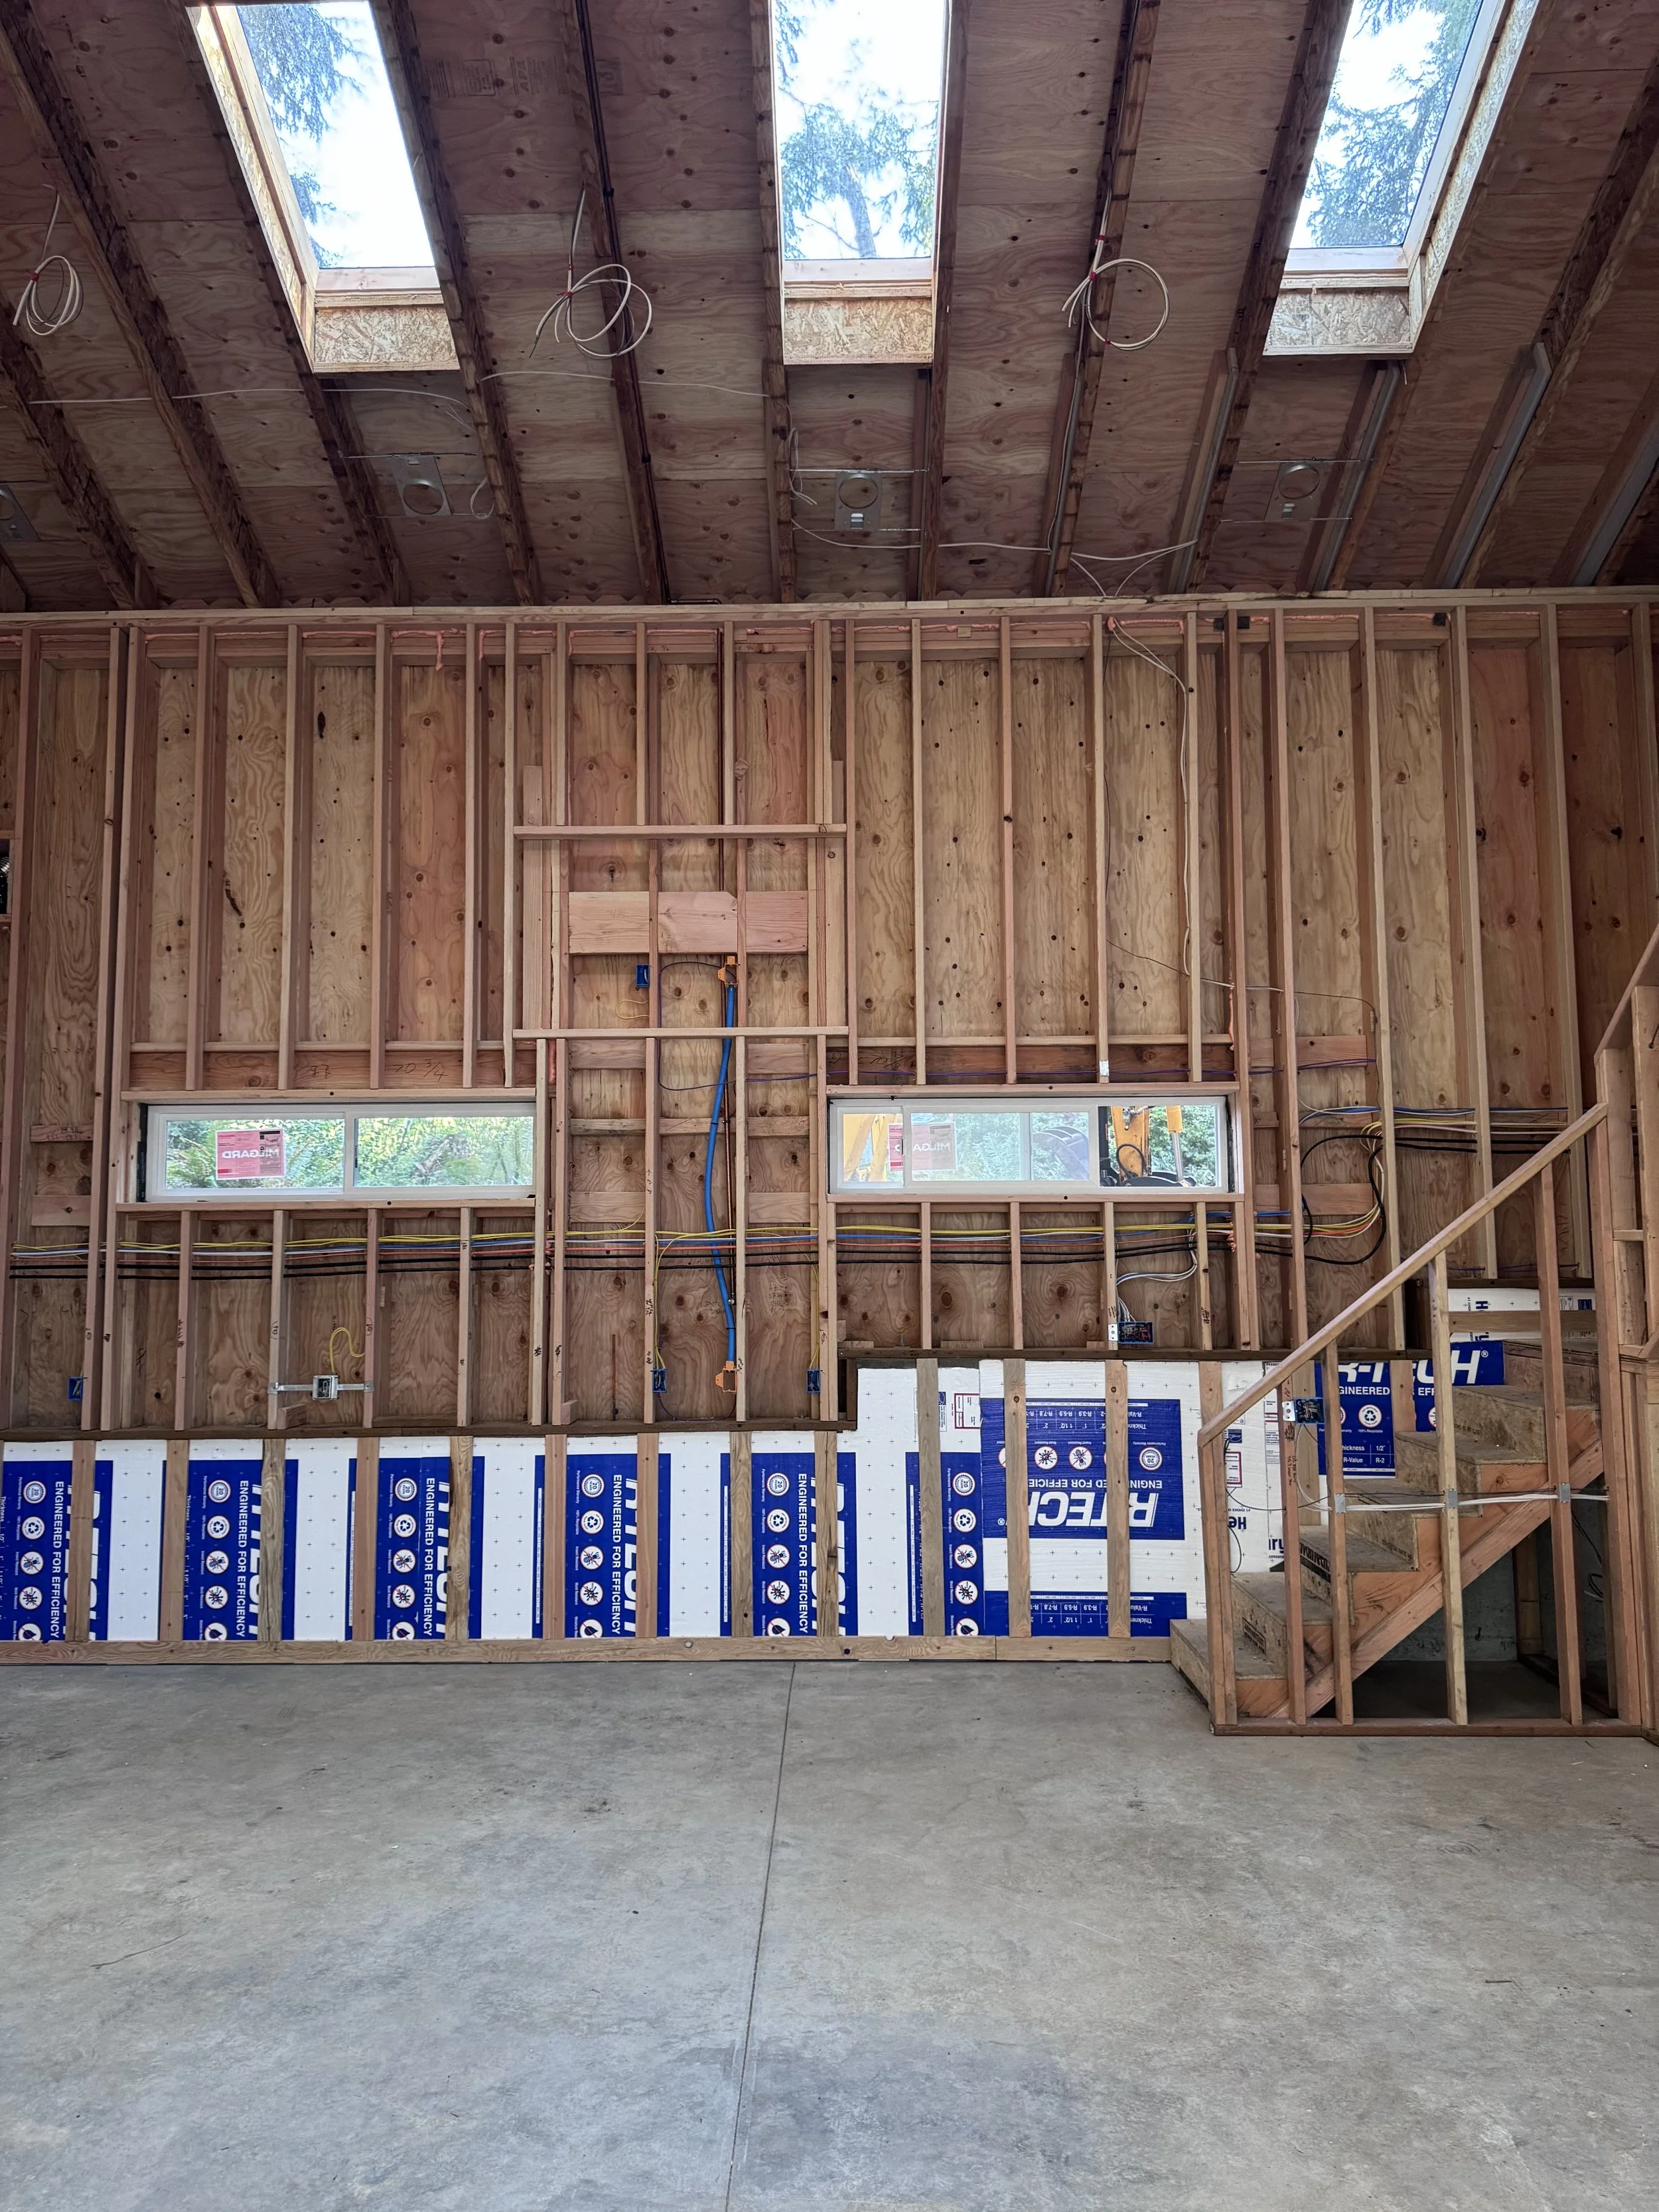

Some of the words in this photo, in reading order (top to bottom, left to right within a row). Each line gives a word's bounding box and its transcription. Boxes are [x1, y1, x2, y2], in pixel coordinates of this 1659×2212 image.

[1340, 1386, 1389, 1395] GINEERED
[425, 1478, 435, 1545] ENGINEERED
[613, 1475, 621, 1542] ENGINEERED
[798, 1474, 807, 1541] ENGINEERED
[1027, 1479, 1067, 1487] EFFICIE
[1072, 1479, 1092, 1487] FOR
[1096, 1478, 1162, 1488] ENGINED
[53, 1481, 64, 1548] ENGINEERED
[238, 1481, 248, 1547] ENGINEERED
[52, 1552, 61, 1572] FOR
[238, 1551, 246, 1572] FOR
[424, 1549, 433, 1570] FOR
[612, 1546, 620, 1568] FOR
[798, 1545, 807, 1566] FOR
[50, 1577, 60, 1637] EFFICIENCY
[236, 1576, 246, 1637] EFFICIENCY
[423, 1574, 433, 1635] EFFICIENCY
[612, 1572, 620, 1634] EFFICIENCY
[799, 1570, 808, 1633] EFFICIENCY
